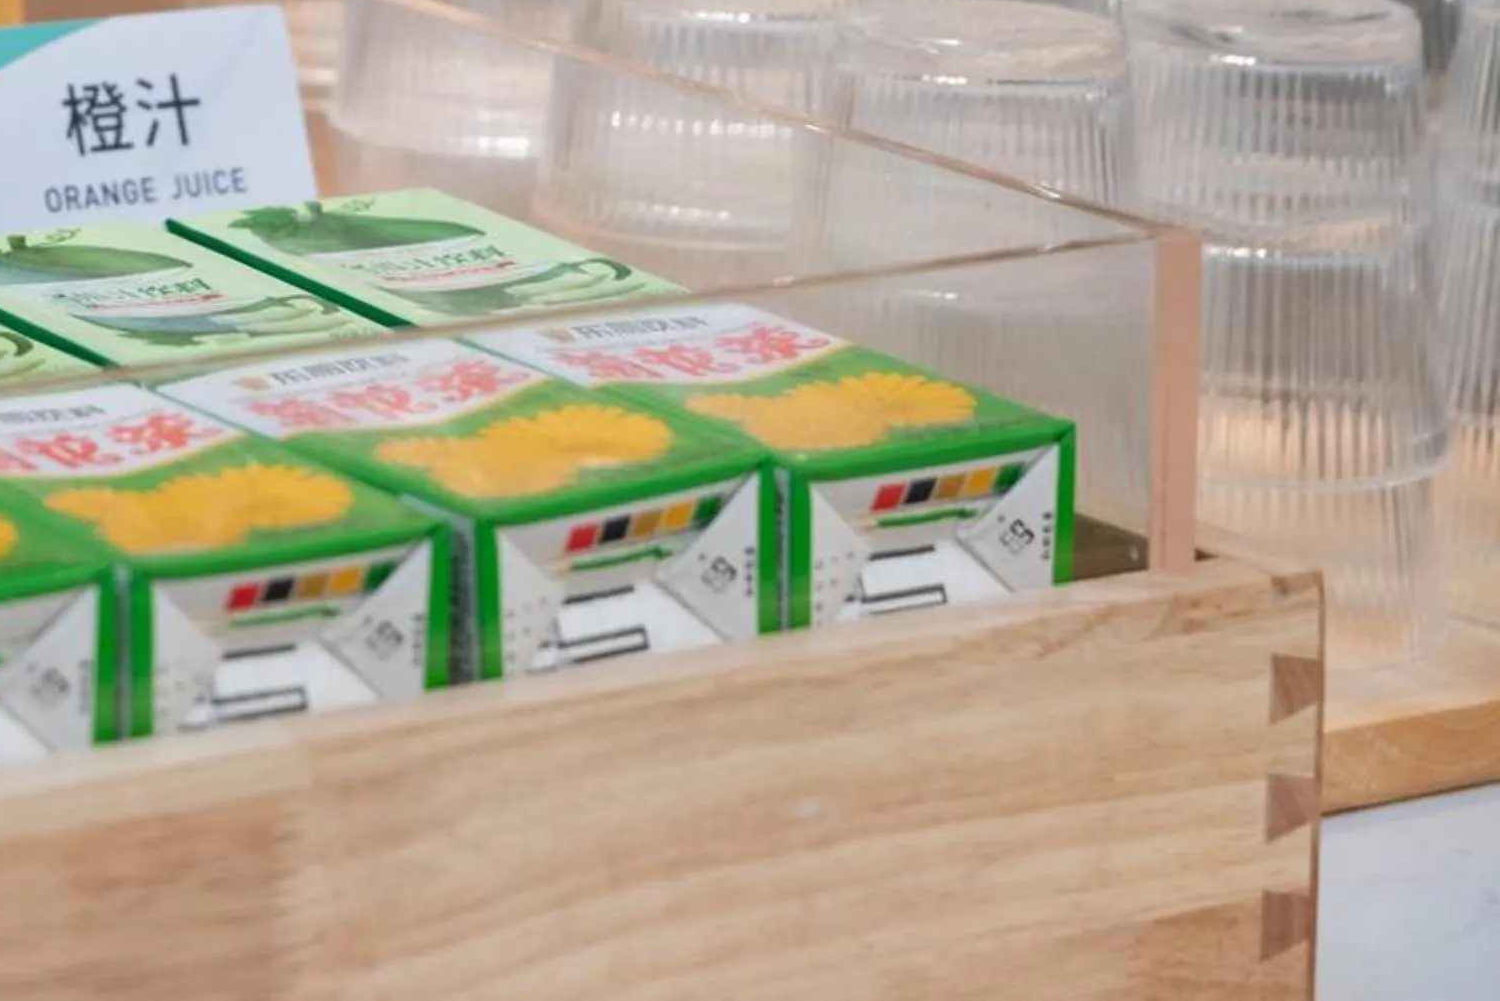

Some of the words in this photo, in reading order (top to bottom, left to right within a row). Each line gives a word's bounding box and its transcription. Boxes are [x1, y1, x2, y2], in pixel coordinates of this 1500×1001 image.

[62, 73, 201, 157] 橙汁
[44, 176, 158, 214] ORANGE
[171, 167, 248, 200] JUICE
